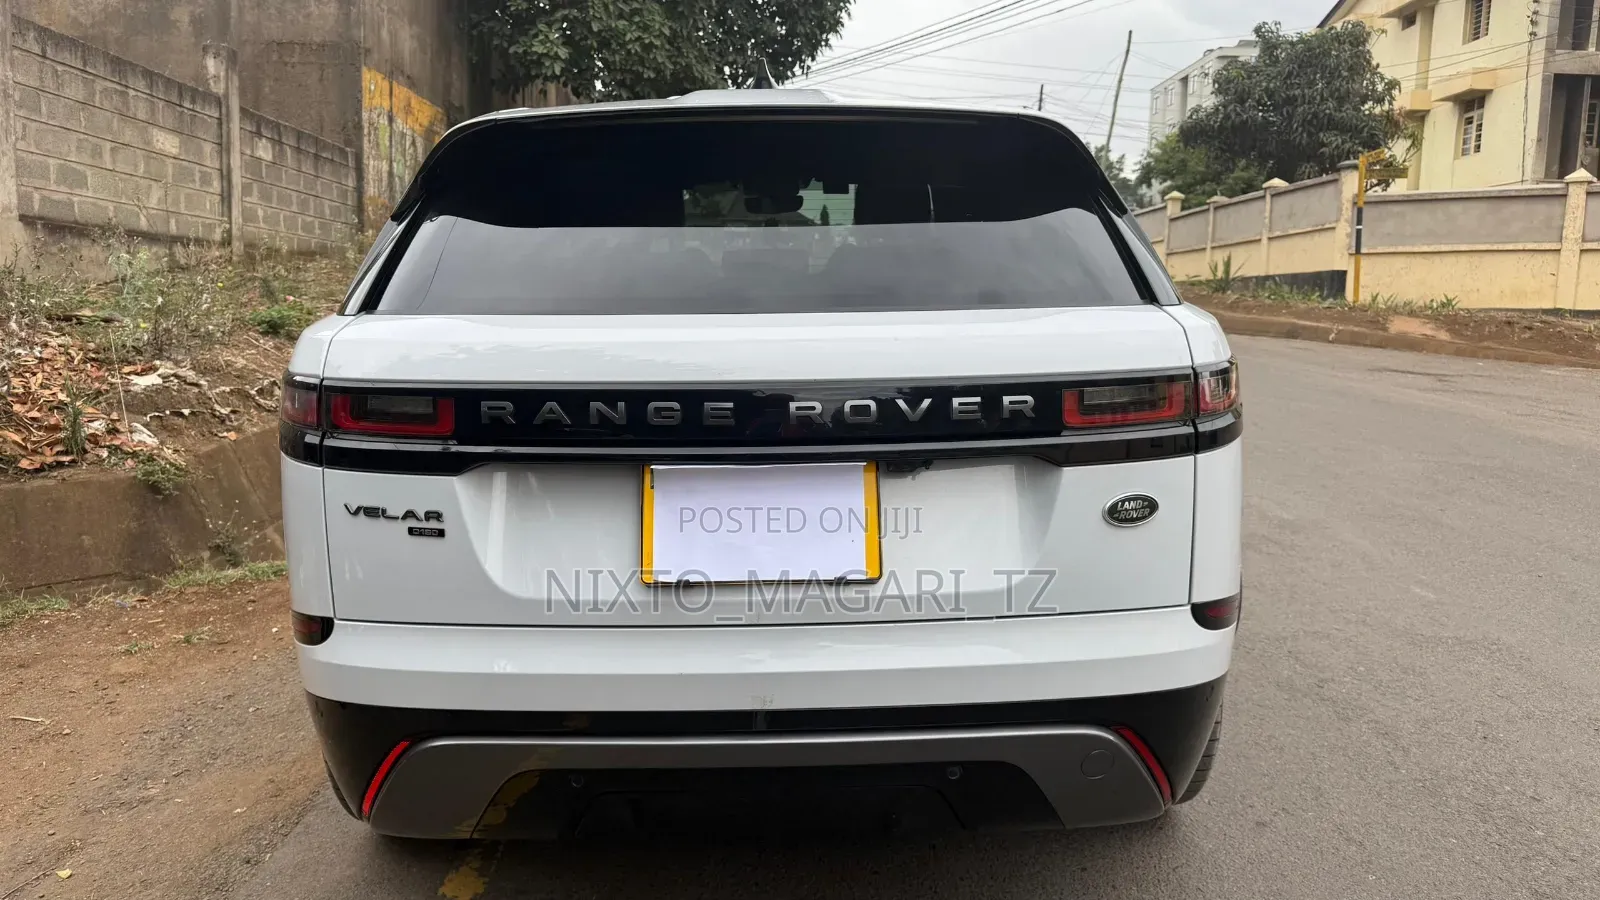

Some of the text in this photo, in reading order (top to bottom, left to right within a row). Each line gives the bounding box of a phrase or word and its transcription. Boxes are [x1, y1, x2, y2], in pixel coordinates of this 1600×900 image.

[480, 394, 1036, 426] RANGE ROVER
[343, 503, 444, 522] VELAR
[1117, 499, 1143, 511] LAND
[1119, 508, 1150, 520] ROVER
